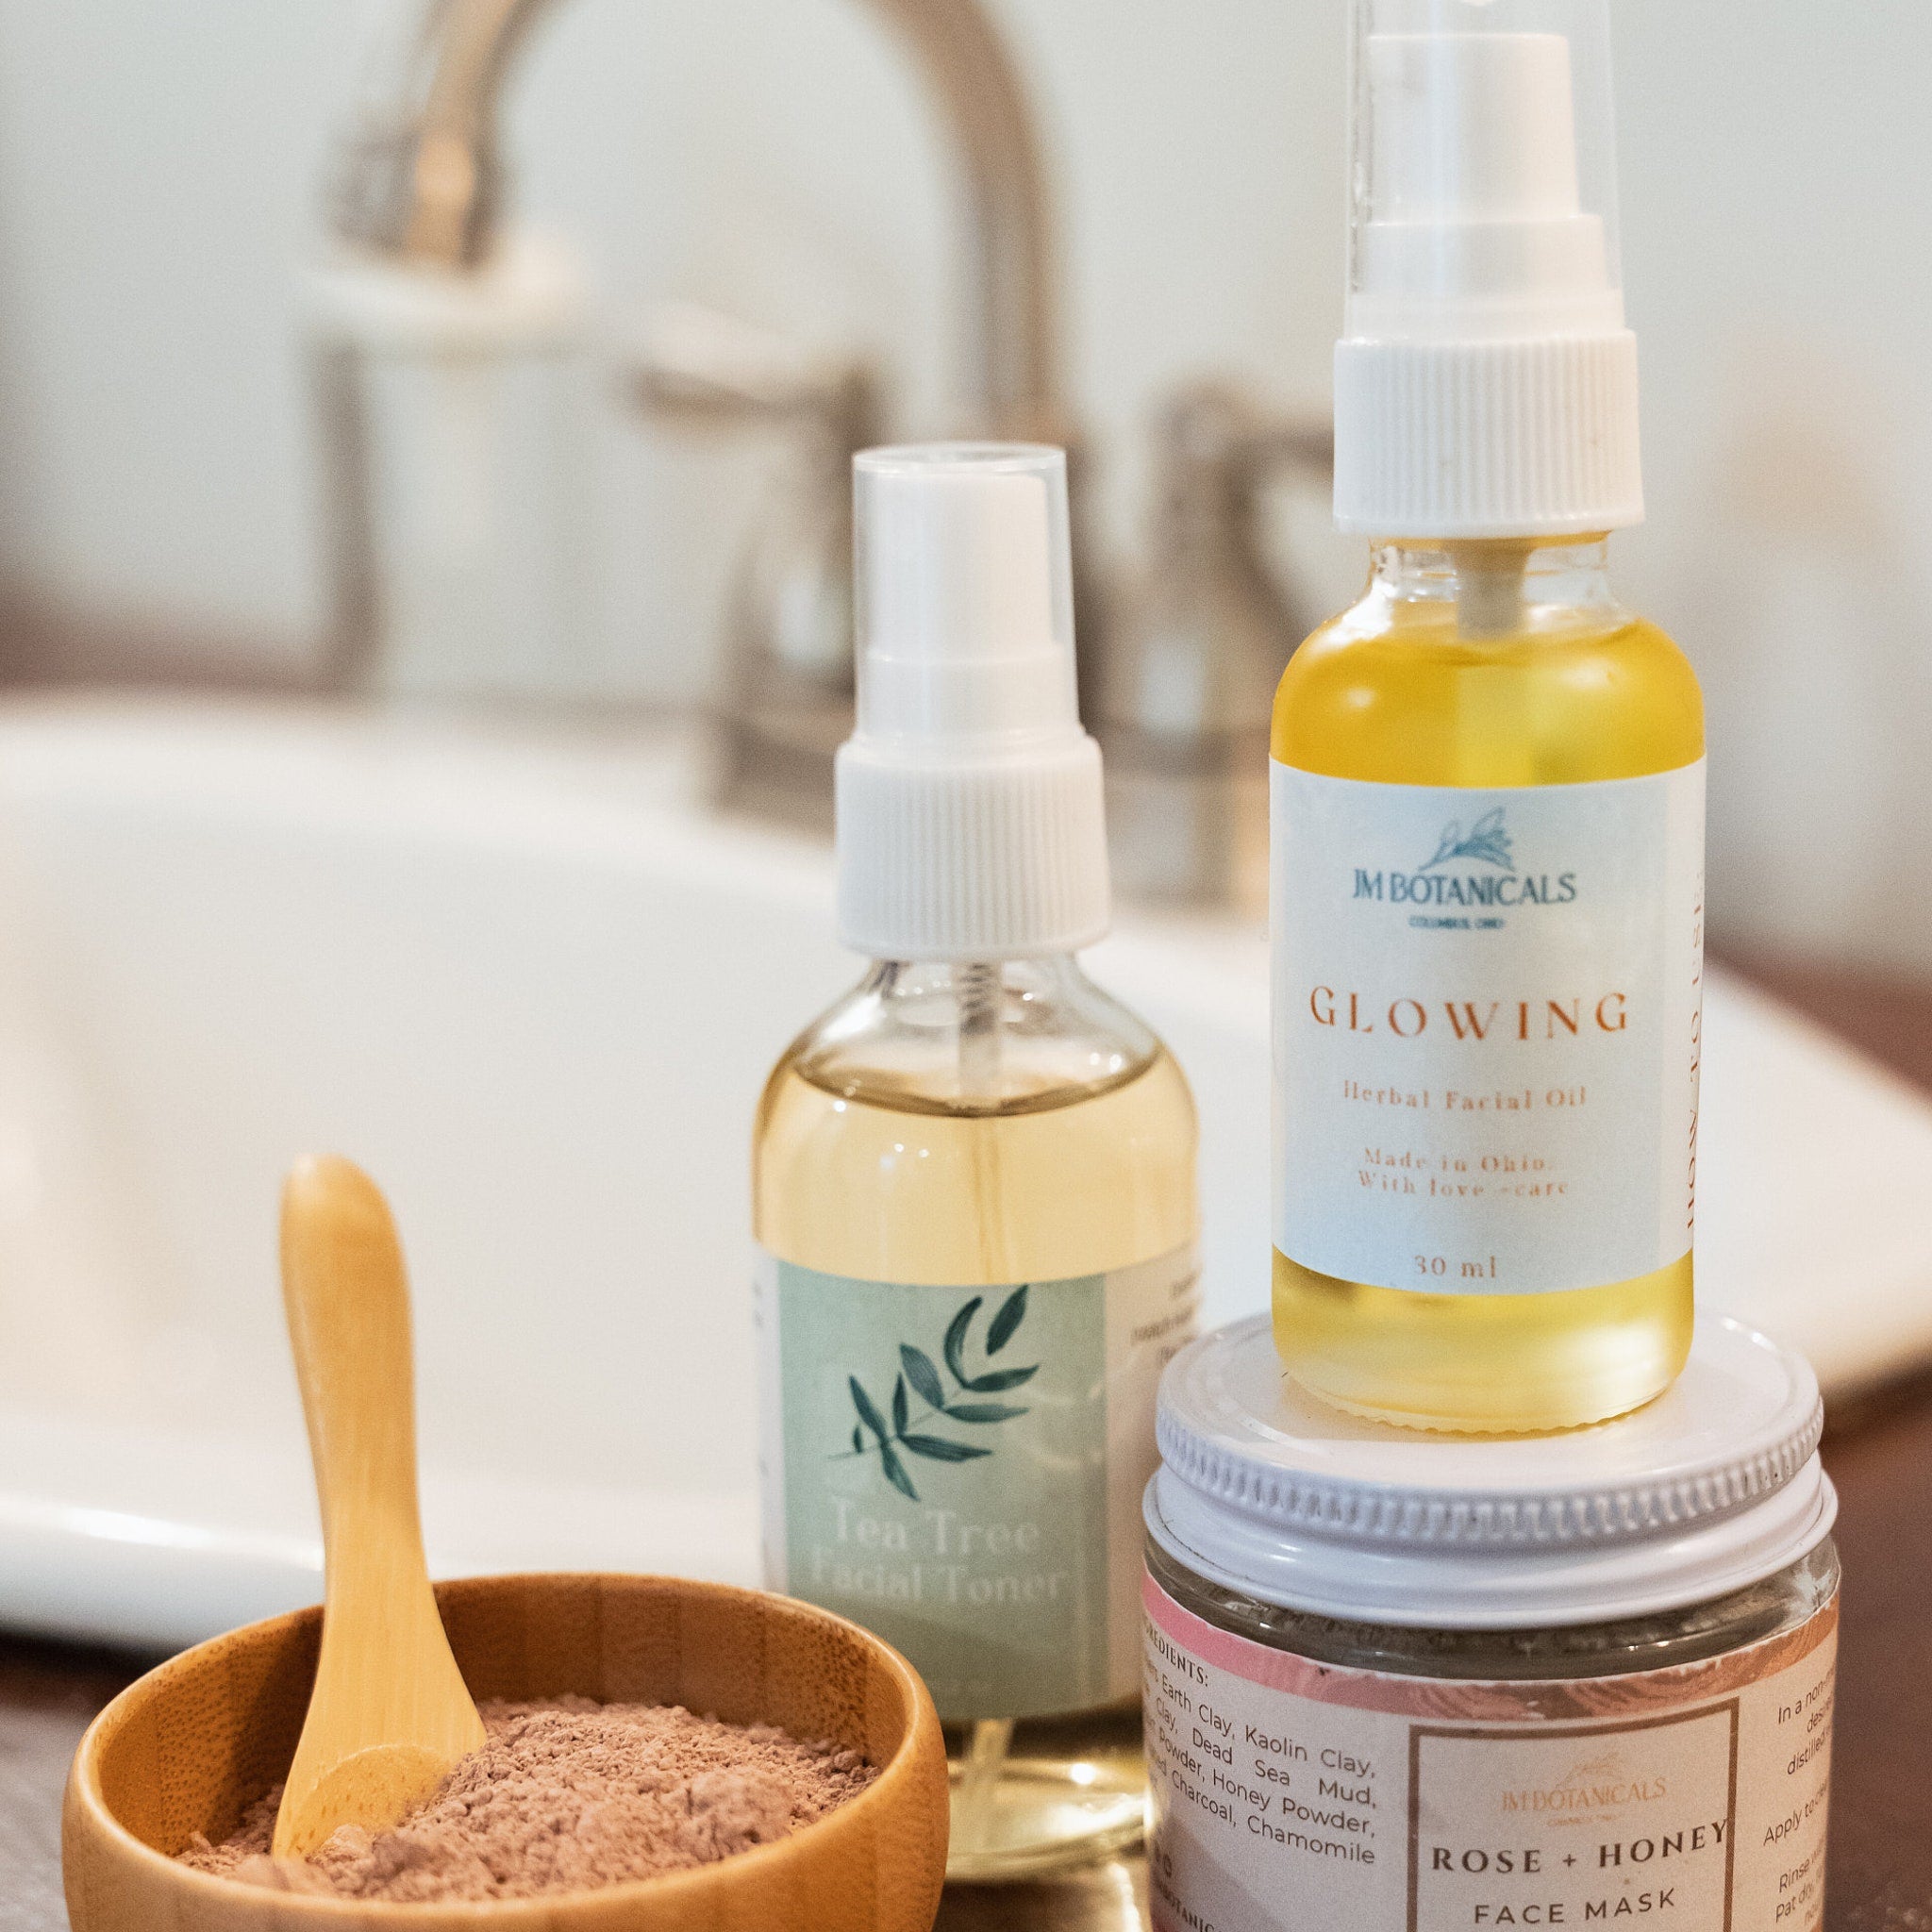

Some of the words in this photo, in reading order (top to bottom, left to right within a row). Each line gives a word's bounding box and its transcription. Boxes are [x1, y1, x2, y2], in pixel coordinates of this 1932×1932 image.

[1390, 872, 1576, 906] BOTANICALS
[1309, 985, 1628, 1041] GLOWING
[1690, 1010, 1699, 1082] TO
[1344, 1079, 1429, 1108] Herbal
[1445, 1090, 1532, 1111] Facial
[1545, 1085, 1586, 1108] Oil
[1365, 1147, 1425, 1170] Made
[1441, 1154, 1466, 1172] in
[1687, 1109, 1697, 1229] HOW
[1358, 1170, 1415, 1194] With
[1430, 1177, 1484, 1197] love
[1414, 1255, 1446, 1275] 30
[1461, 1255, 1496, 1278] ml
[832, 1495, 908, 1551] Tea
[924, 1509, 1039, 1556] Tree
[811, 1547, 923, 1601] Facial
[945, 1564, 1068, 1604] Toner
[1161, 1674, 1191, 1713] Earth
[1199, 1704, 1235, 1740] Clay,
[1246, 1724, 1307, 1761] Kaolin
[1321, 1749, 1375, 1778] Clay,
[1778, 1706, 1791, 1724] In
[1794, 1700, 1802, 1714] a
[1157, 1697, 1178, 1735] Clay,
[1192, 1727, 1233, 1765] Dead
[1256, 1759, 1291, 1787] Sea
[1319, 1777, 1376, 1809] Mud,
[1159, 1726, 1205, 1782] Powder,
[1213, 1768, 1271, 1811] Honey
[1283, 1797, 1375, 1839] Powder,
[1172, 1770, 1237, 1827] Charcoal,
[1247, 1815, 1375, 1864] Chamomile
[1763, 1808, 1803, 1846] Apply
[1432, 1846, 1541, 1874] ROSE
[1562, 1854, 1576, 1868] +
[1599, 1818, 1727, 1868] HONEY
[1779, 1858, 1809, 1893] Rinse
[1474, 1904, 1564, 1924] FACE
[1585, 1887, 1675, 1921] MASK
[1775, 1896, 1795, 1924] Pat
